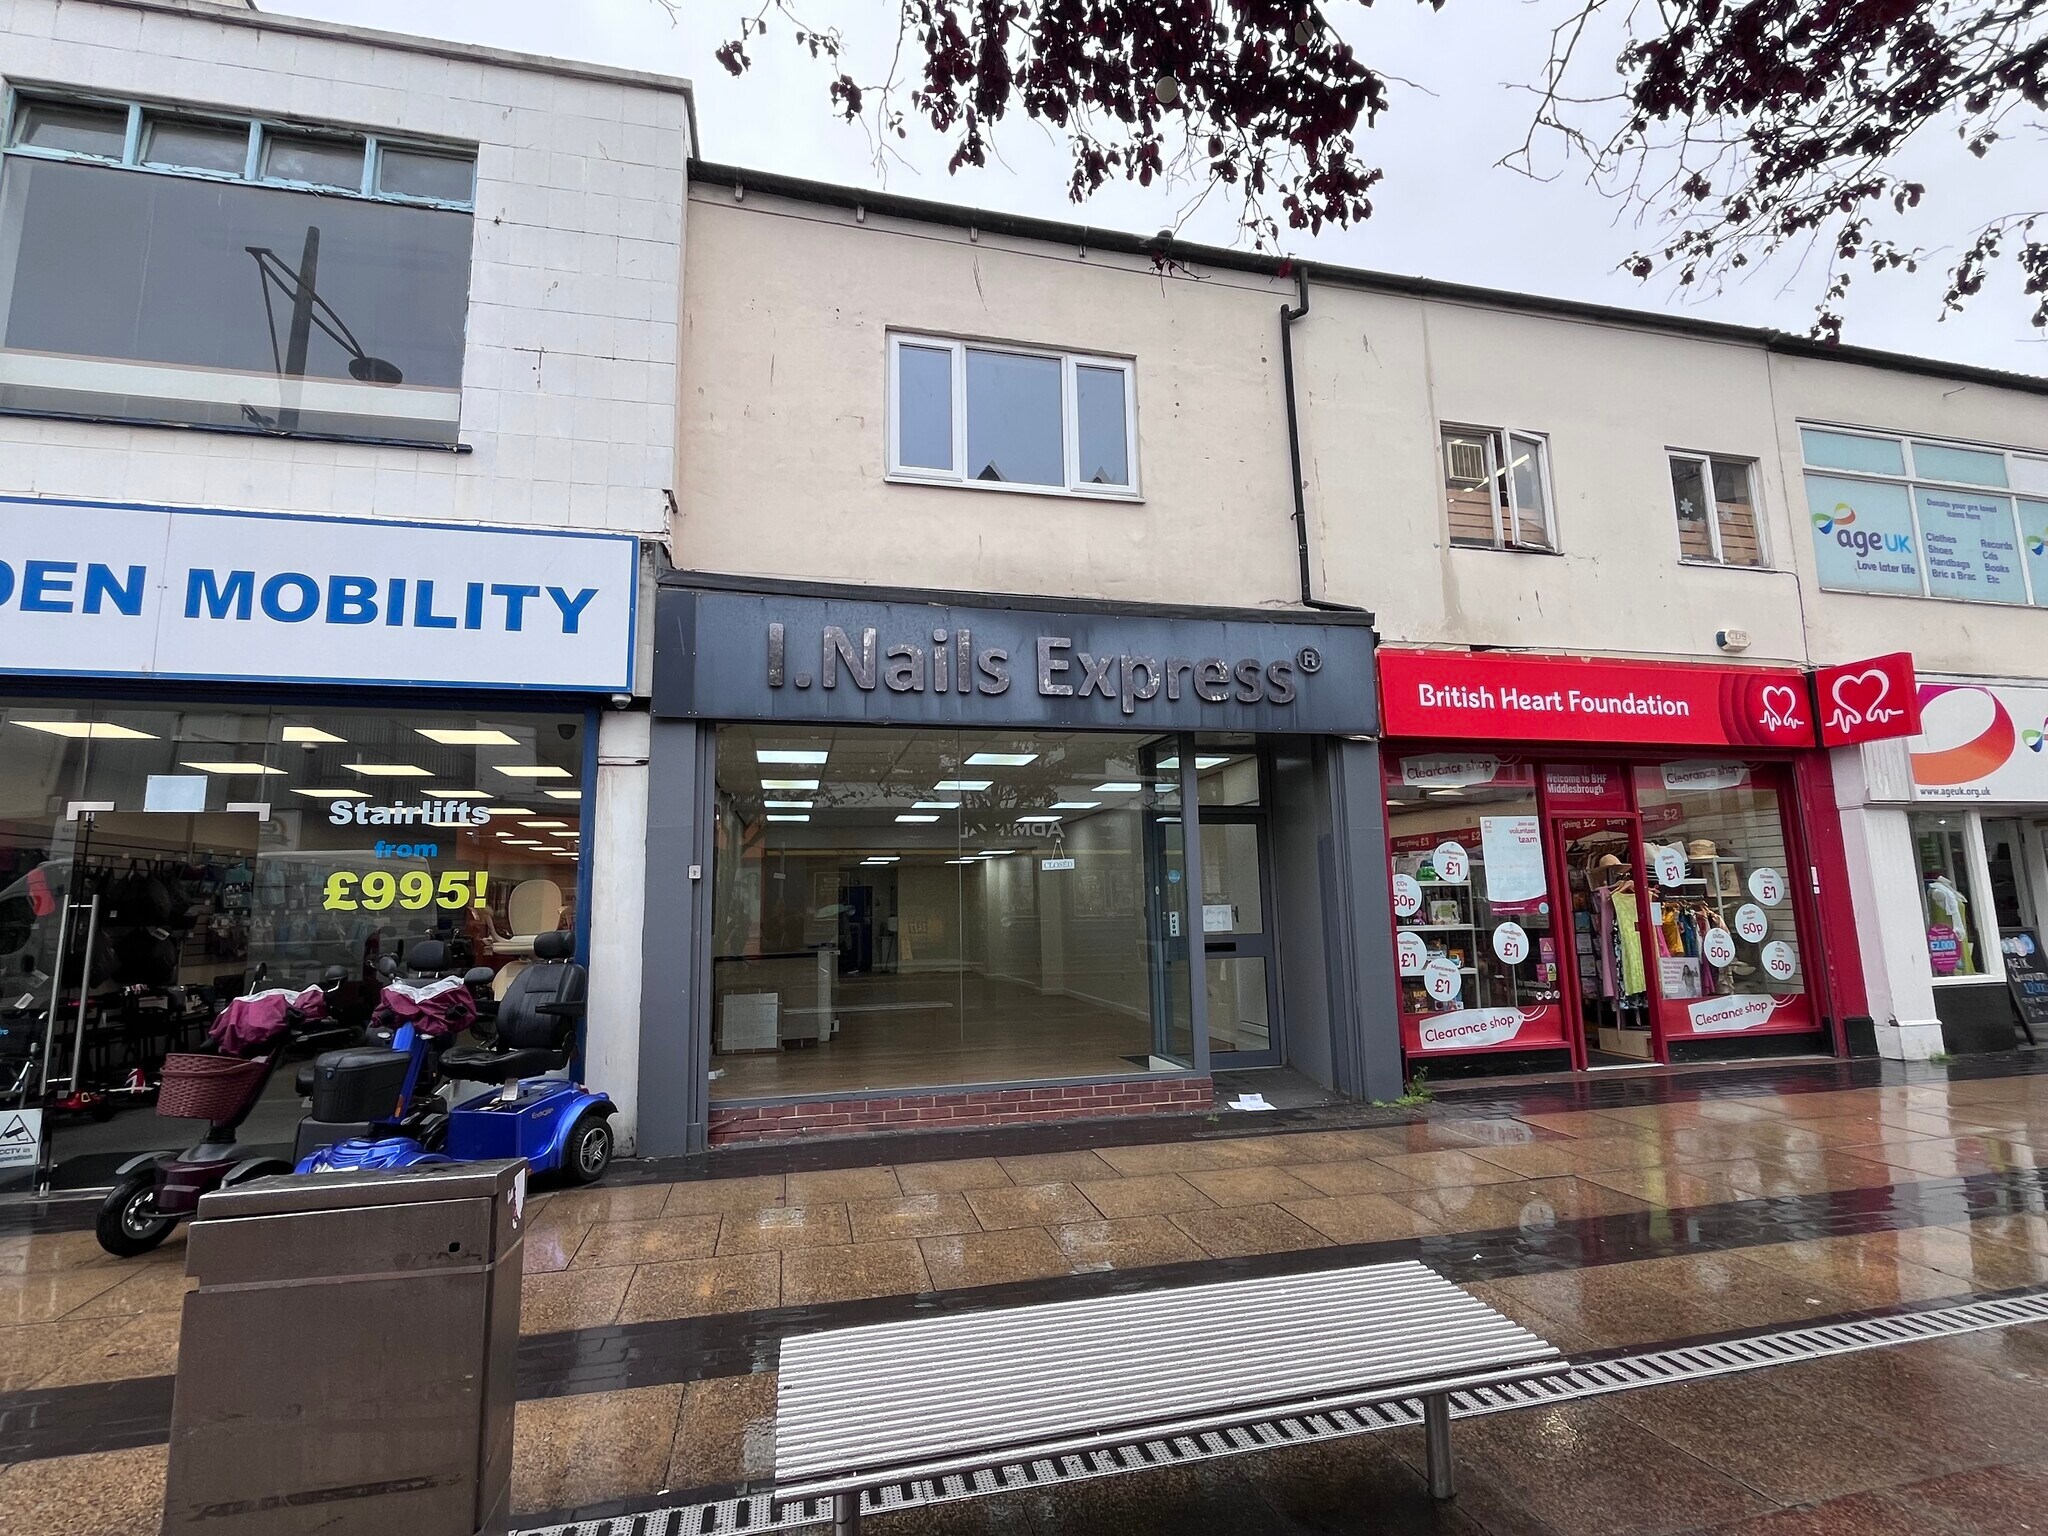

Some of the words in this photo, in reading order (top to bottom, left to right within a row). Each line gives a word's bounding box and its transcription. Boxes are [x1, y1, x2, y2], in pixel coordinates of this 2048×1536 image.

[1926, 532, 1957, 544] Clothes
[1981, 539, 2013, 550] Records
[1928, 545, 1953, 555] Shoes
[1857, 560, 1877, 571] Love
[1879, 561, 1899, 573] later
[1901, 562, 1916, 574] life
[1930, 557, 1970, 570] Handbags
[1985, 563, 2010, 573] Books
[1932, 569, 1948, 578] Bric
[1957, 571, 1976, 581] Brac
[1987, 574, 2000, 584] Etc
[0, 558, 147, 617] EN
[184, 569, 599, 634] MOBILITY
[1418, 683, 1495, 709] British
[1500, 687, 1563, 712] Heart
[1569, 690, 1690, 716] Foundation
[1407, 763, 1463, 780] Clearance
[1466, 759, 1492, 773] shop
[1666, 768, 1716, 784] Clearance
[1718, 764, 1739, 778] shop
[1547, 774, 1580, 783] Welcome
[1582, 775, 1590, 783] to
[1591, 774, 1607, 783] BHF
[1547, 784, 1604, 796] Middlesbrough
[1920, 786, 1991, 797] www.ageuk.org.uk
[329, 800, 491, 826] Stairlifts
[375, 840, 438, 858] from
[1044, 861, 1073, 869] CLOSED
[1446, 862, 1461, 877] £1
[1666, 866, 1680, 881] £1
[322, 870, 489, 911] £995!
[1763, 886, 1776, 899] £1
[1742, 922, 1763, 935] 50p
[1503, 942, 1519, 957] £1
[1711, 946, 1730, 960] 50p
[1401, 953, 1416, 967] £1
[1771, 960, 1791, 974] 50p
[1435, 978, 1450, 994] £1
[1695, 1008, 1743, 1026] Clearance
[1745, 1000, 1767, 1014] shop
[1425, 1020, 1487, 1042] Clearance
[1491, 1014, 1515, 1029] shop
